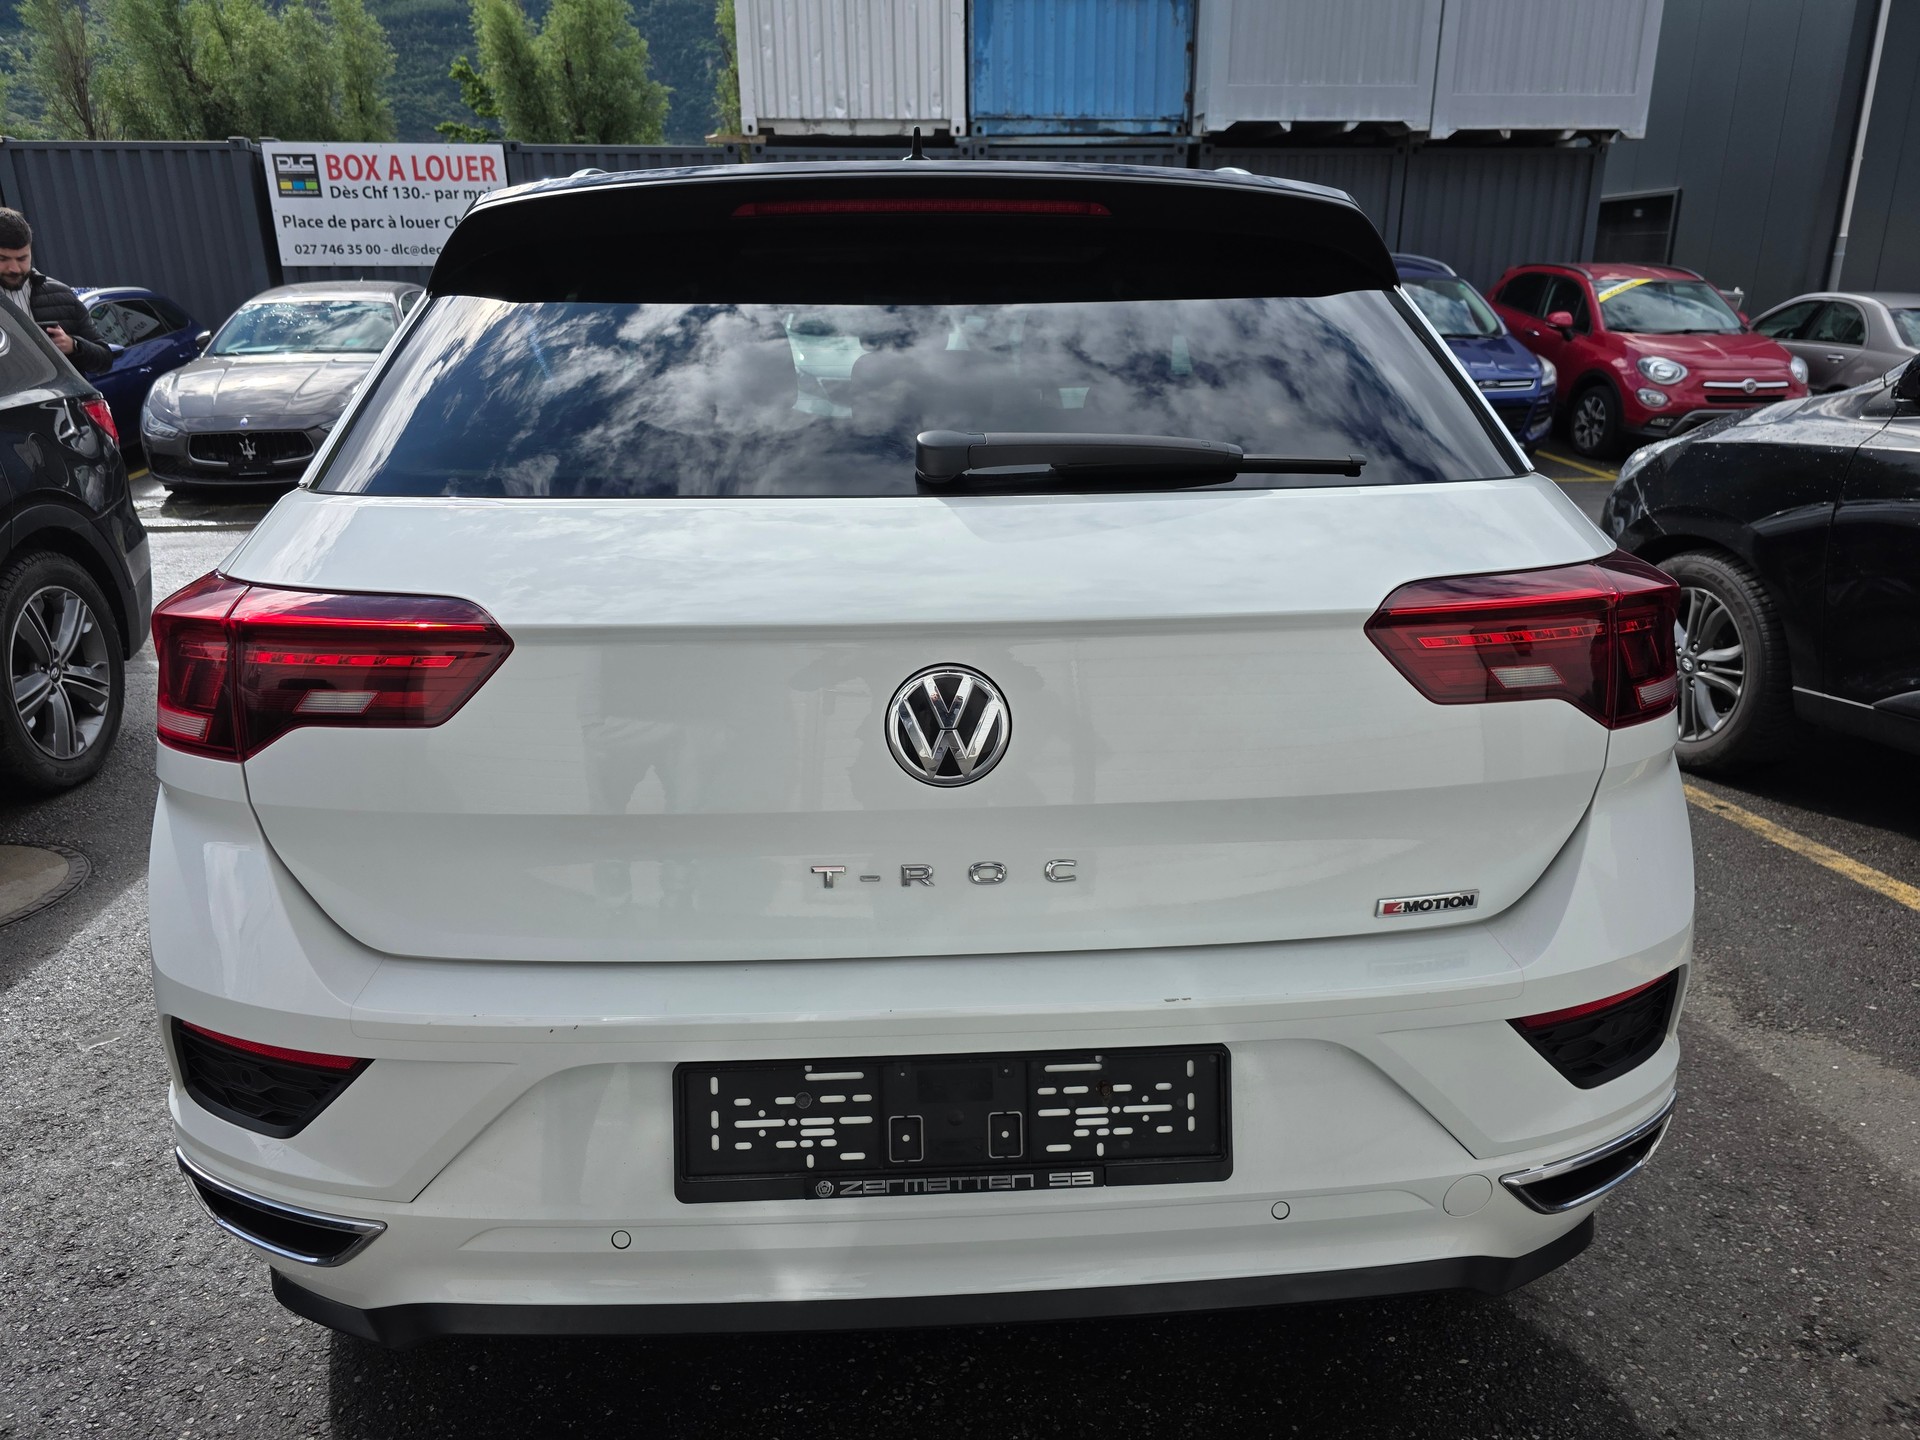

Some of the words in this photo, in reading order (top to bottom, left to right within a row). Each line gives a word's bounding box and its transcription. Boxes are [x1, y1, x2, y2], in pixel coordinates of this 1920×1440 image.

[276, 156, 314, 170] DLC
[325, 154, 381, 181] BOX
[388, 155, 406, 181] A
[411, 154, 497, 182] LOUER
[330, 185, 359, 199] Dès
[362, 185, 388, 199] Chf
[393, 186, 430, 199] 130.-
[434, 189, 459, 203] par
[282, 214, 324, 229] Place
[327, 214, 347, 229] de
[351, 218, 385, 232] parc
[388, 214, 397, 229] à
[400, 215, 440, 229] louer
[294, 244, 317, 255] 027
[320, 244, 345, 255] 746
[347, 244, 363, 255] 35
[365, 244, 381, 255] 00
[810, 859, 1077, 889] T-ROC
[1393, 894, 1475, 912] 4MOTION
